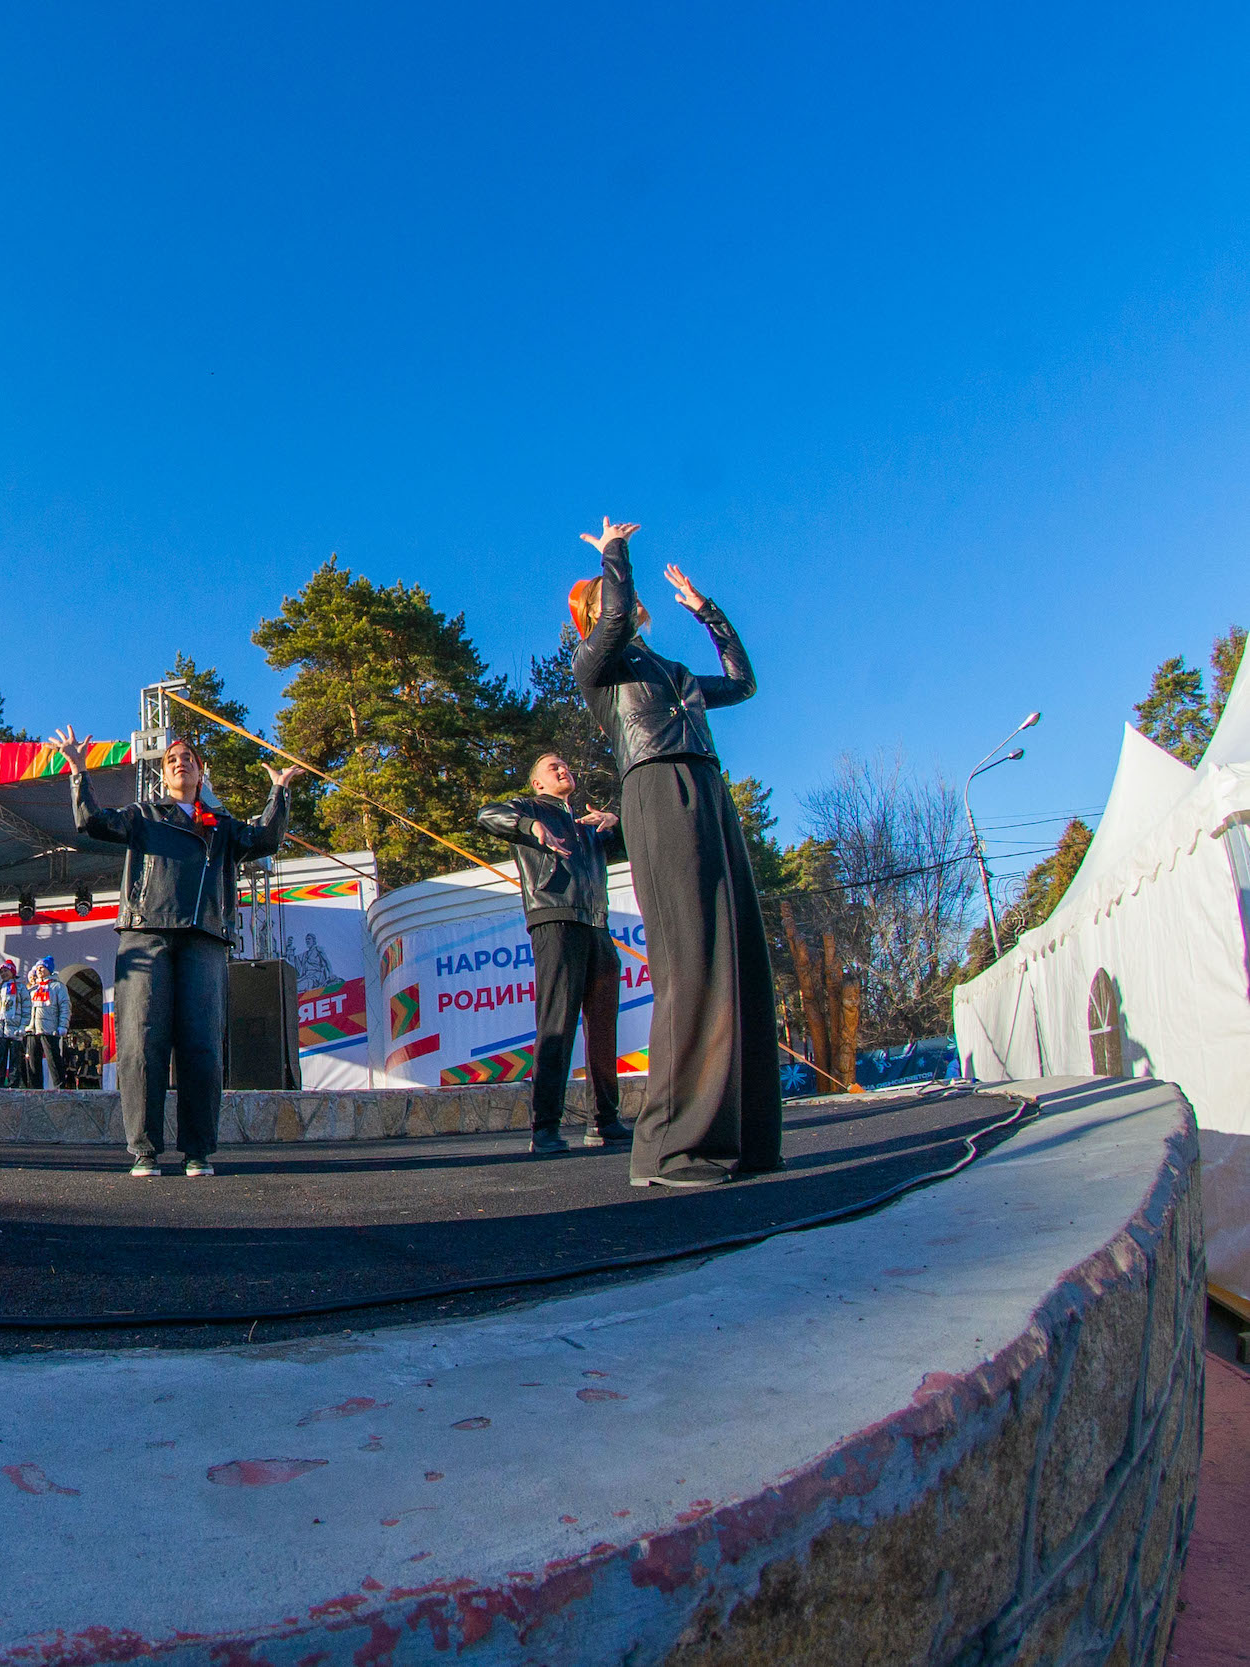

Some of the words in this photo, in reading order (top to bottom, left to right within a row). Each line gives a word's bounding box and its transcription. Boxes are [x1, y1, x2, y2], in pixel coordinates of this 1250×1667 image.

[436, 943, 535, 977] НАРОД
[298, 993, 348, 1023] ЯЕТ
[438, 981, 536, 1013] РОДИН
